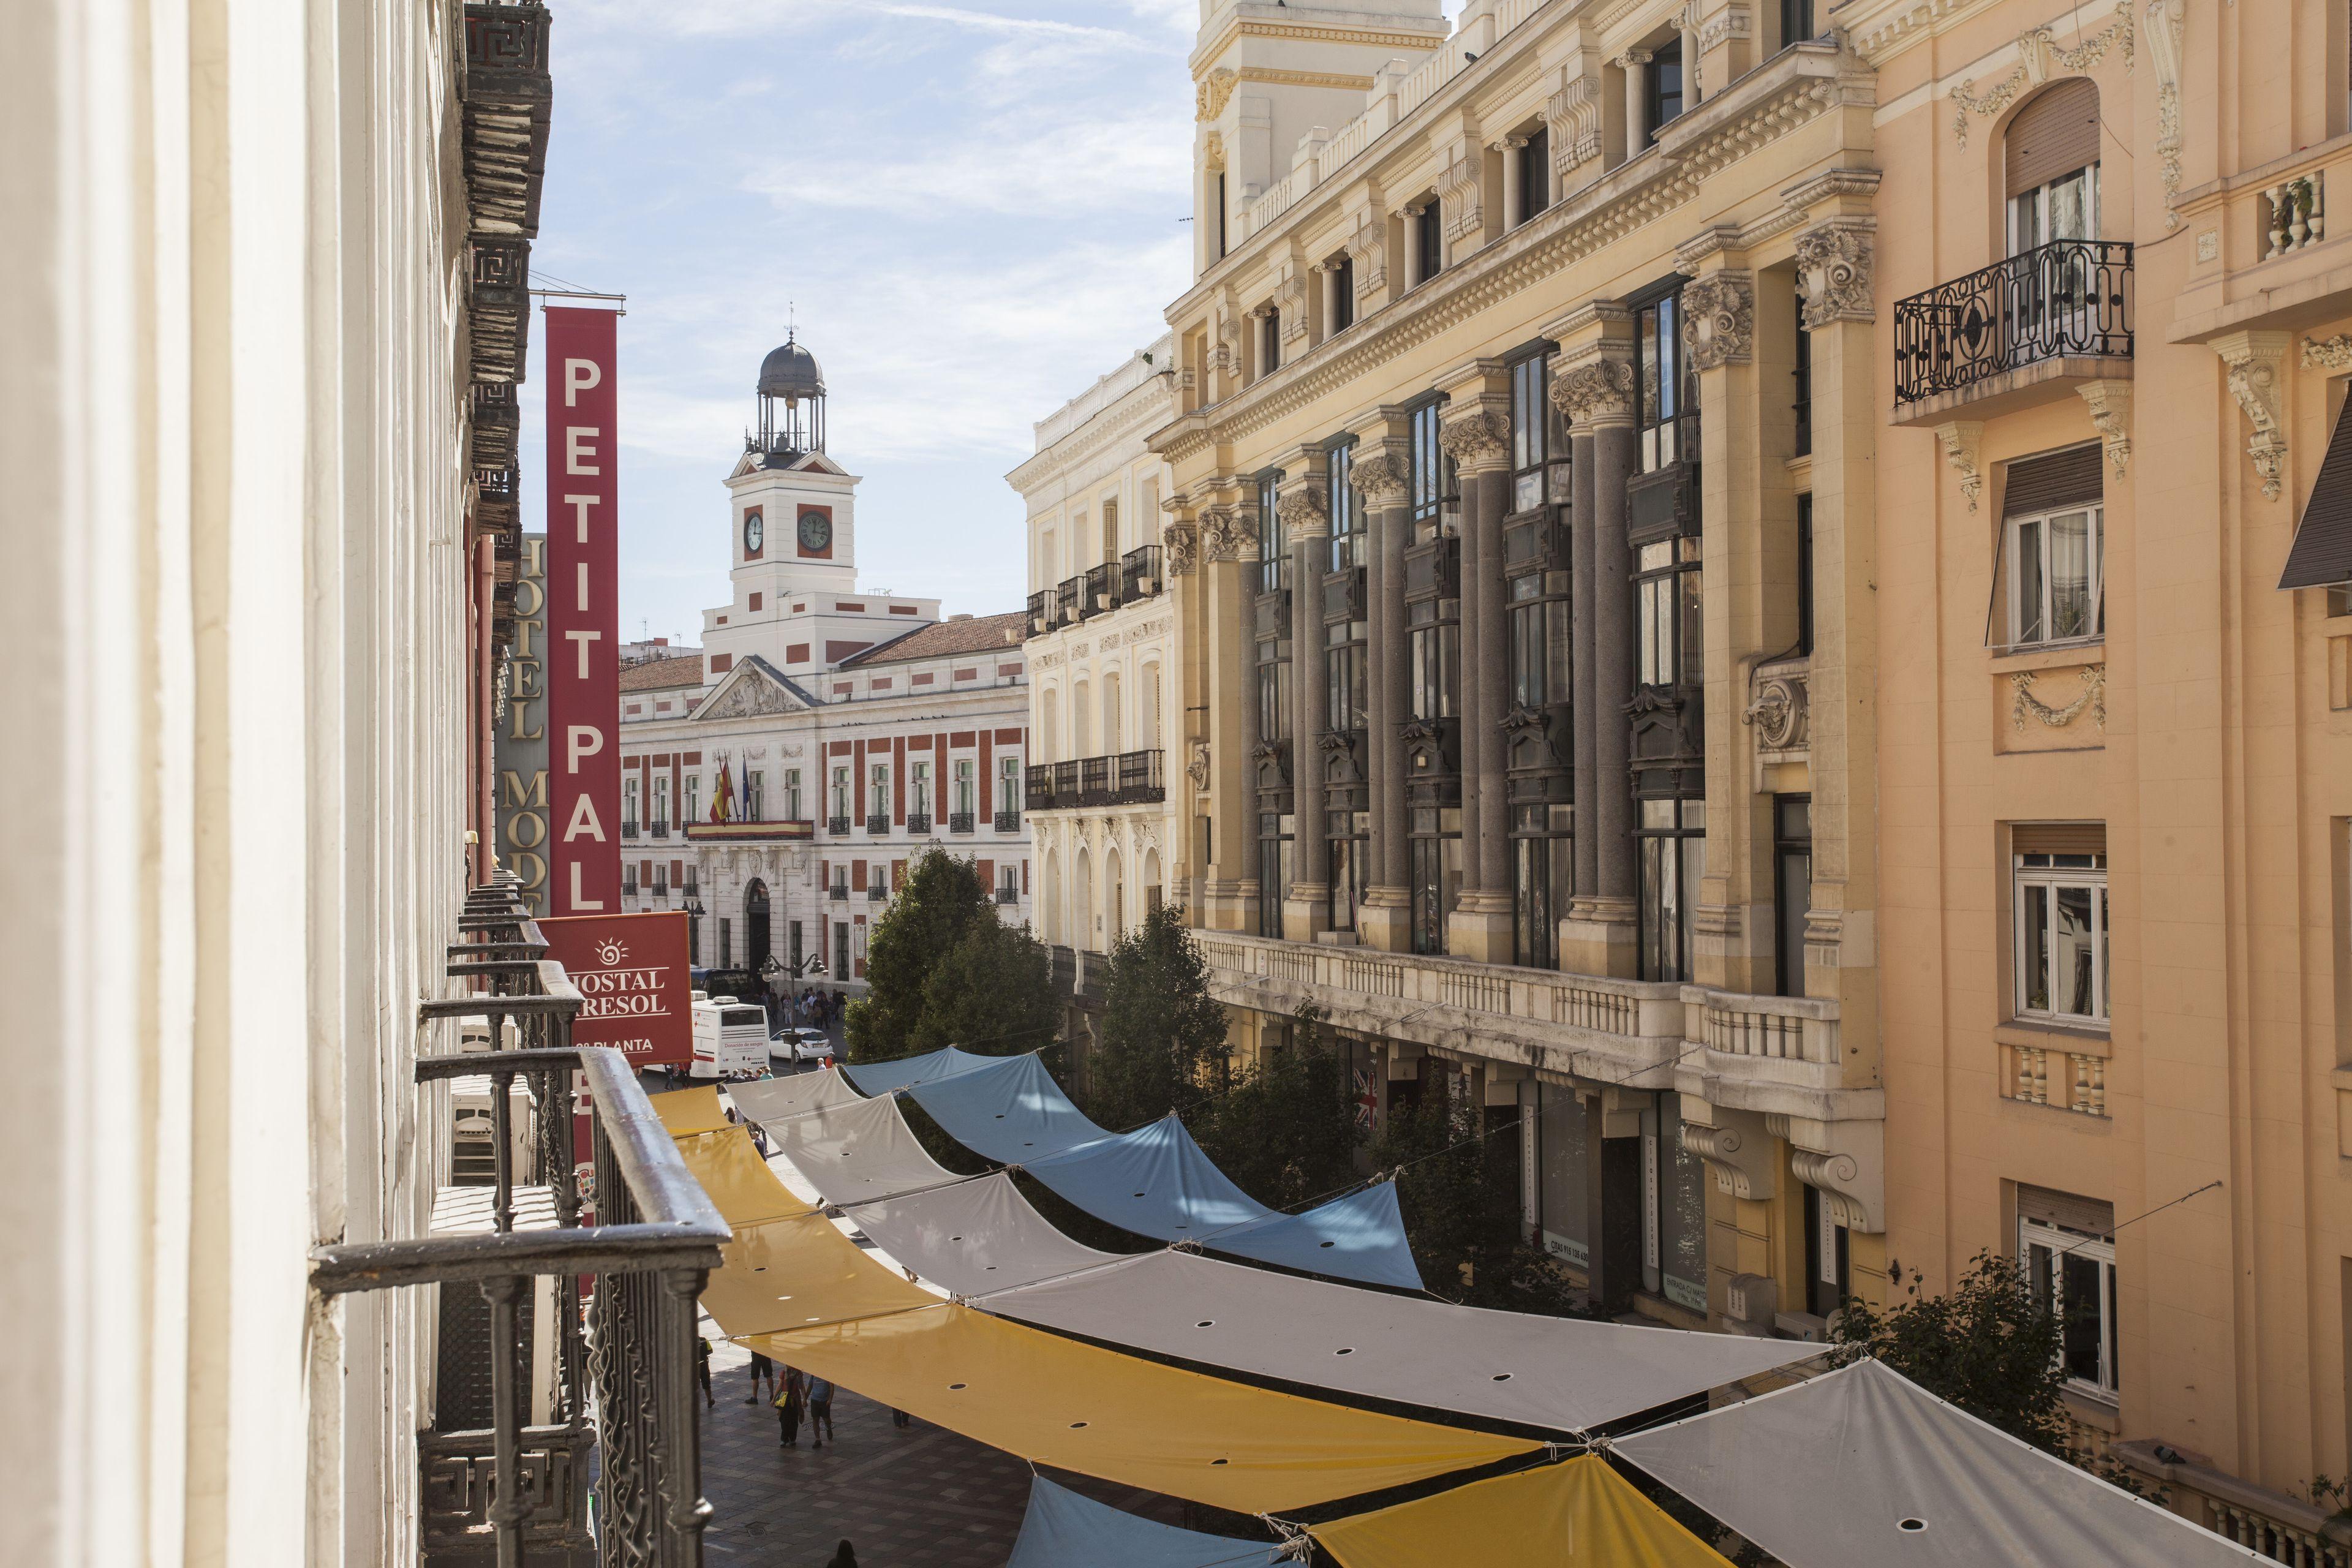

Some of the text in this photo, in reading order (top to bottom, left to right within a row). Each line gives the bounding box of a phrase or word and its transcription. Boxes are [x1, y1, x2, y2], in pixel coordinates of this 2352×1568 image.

[564, 358, 601, 679] PETIT
[1551, 1240, 1563, 1253] CITAS
[1667, 1278, 1686, 1292] ENTRADA
